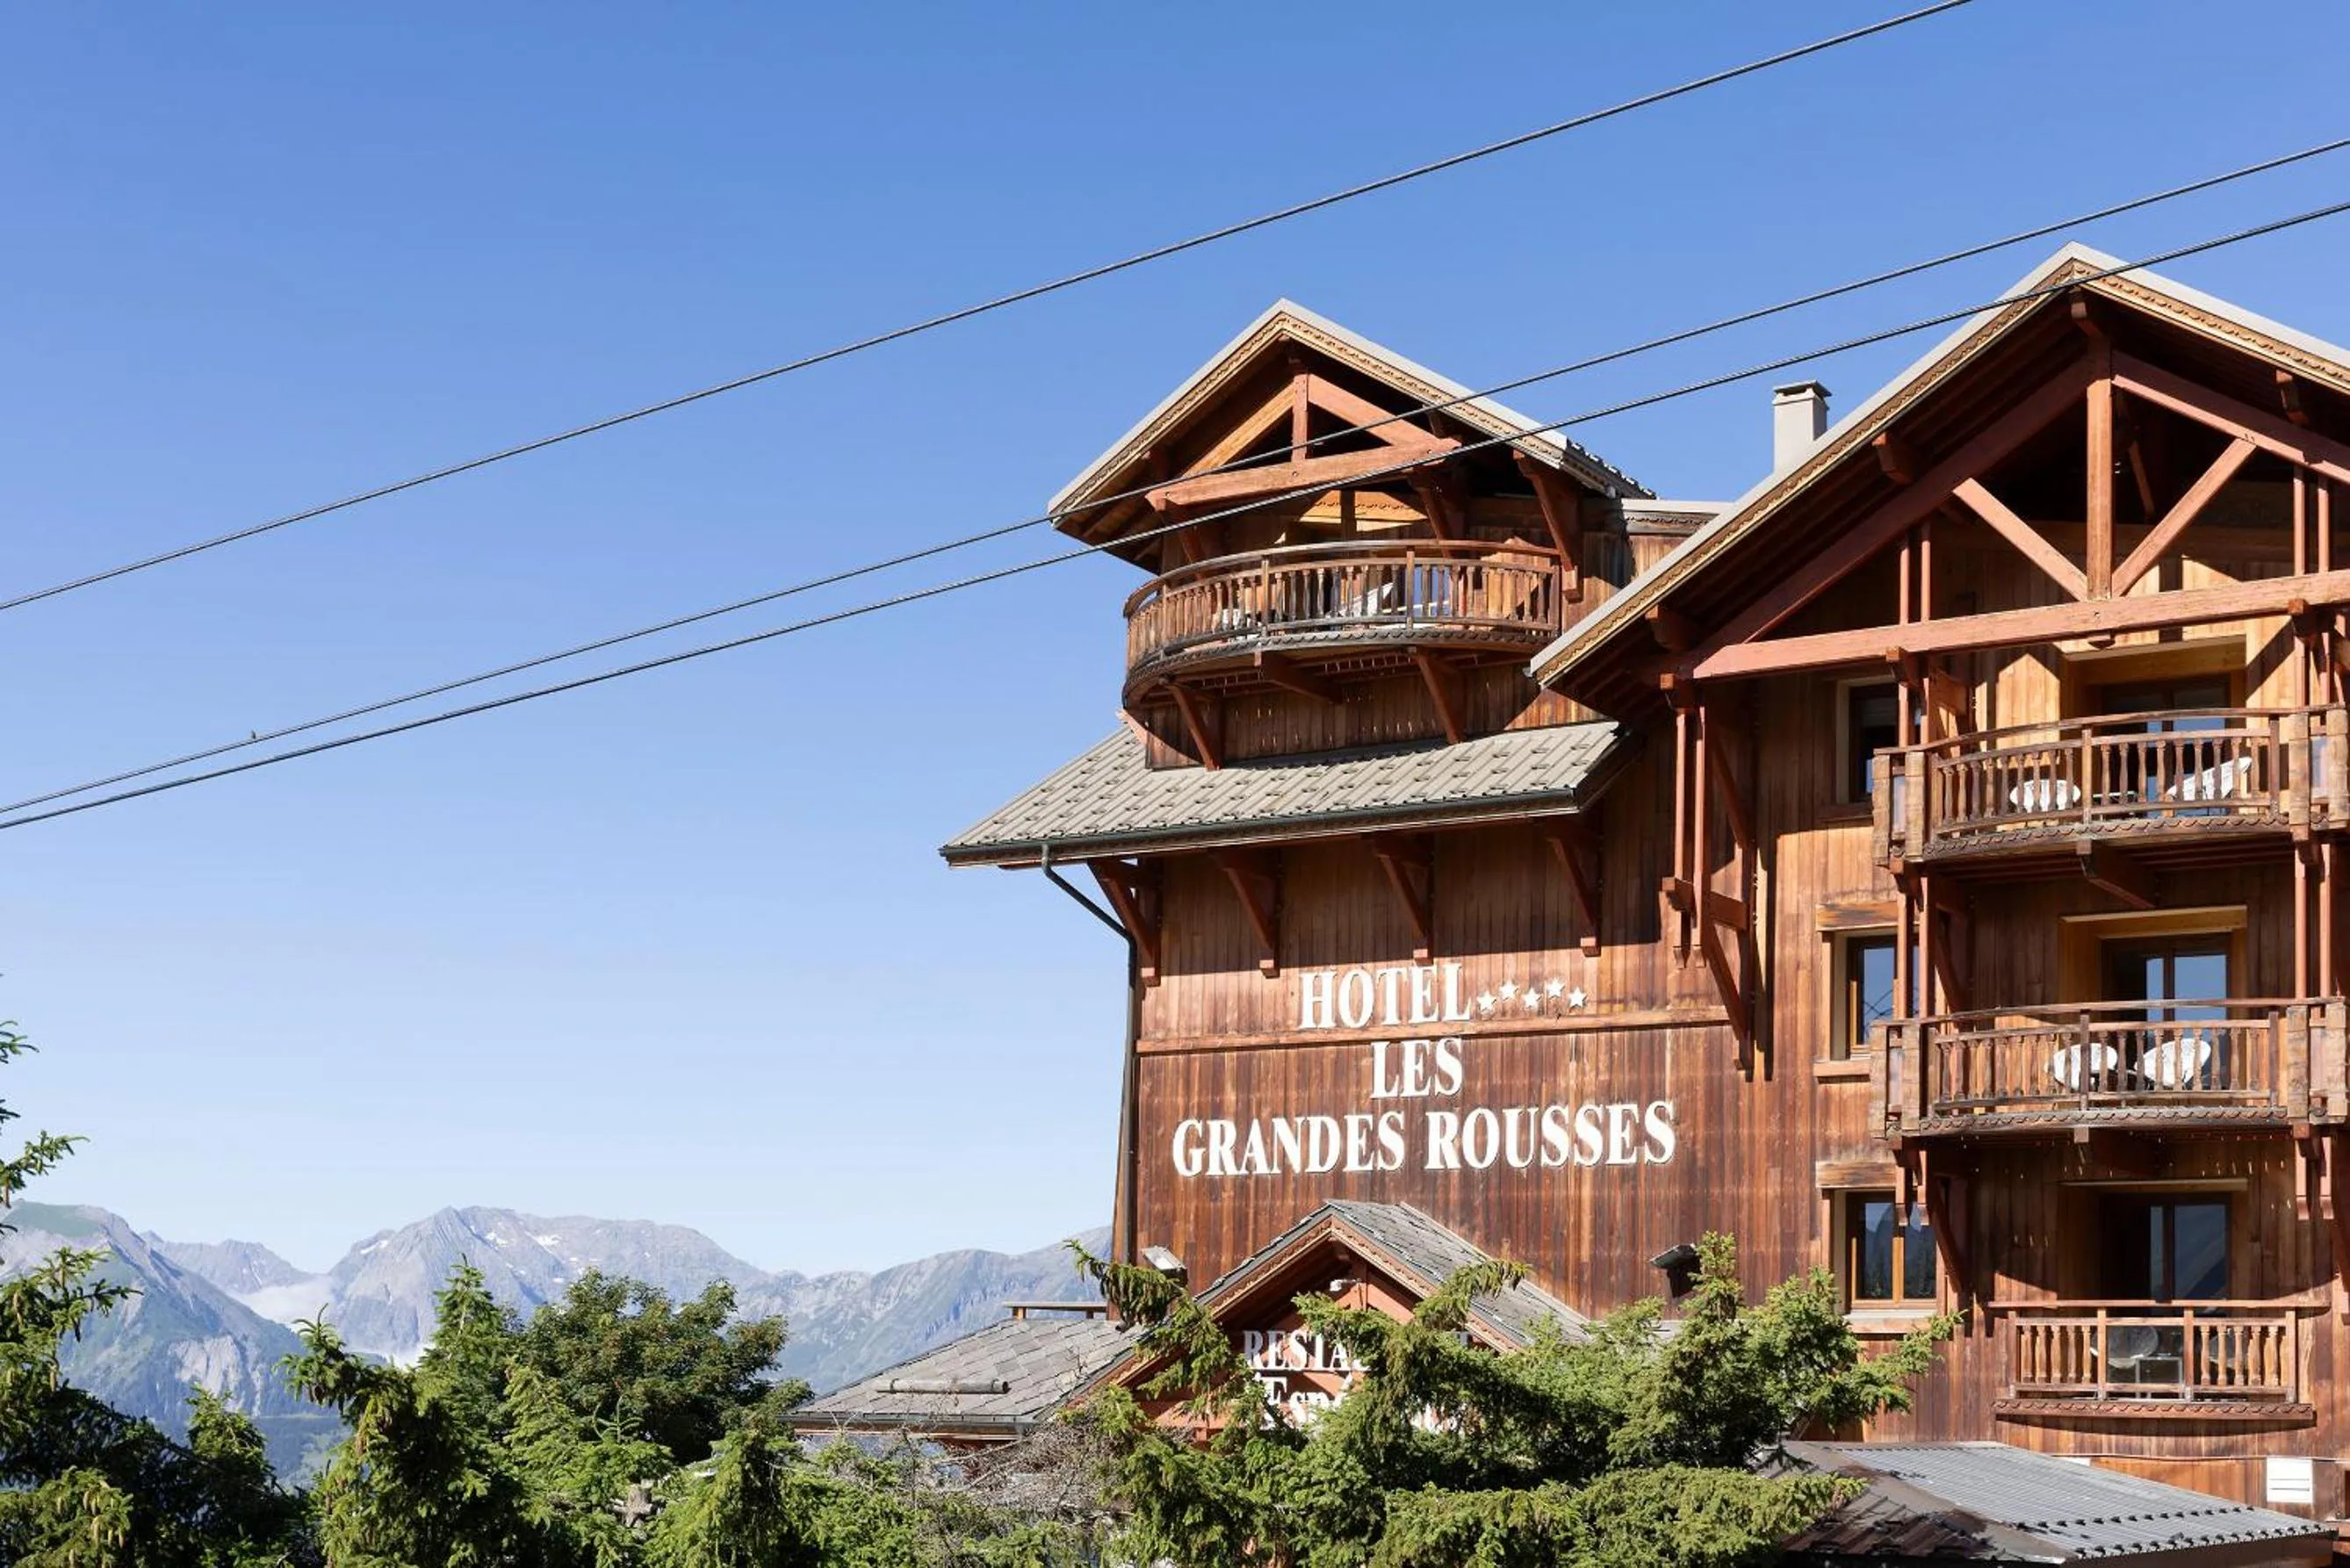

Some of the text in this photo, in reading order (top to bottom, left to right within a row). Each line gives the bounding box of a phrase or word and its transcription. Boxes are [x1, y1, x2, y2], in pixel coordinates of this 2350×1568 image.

[1298, 961, 1472, 1030] HOTEL
[1369, 1038, 1464, 1099] LES
[1171, 1100, 1676, 1178] GRANDES ROUSSES
[1243, 1329, 1372, 1372] RESTA
